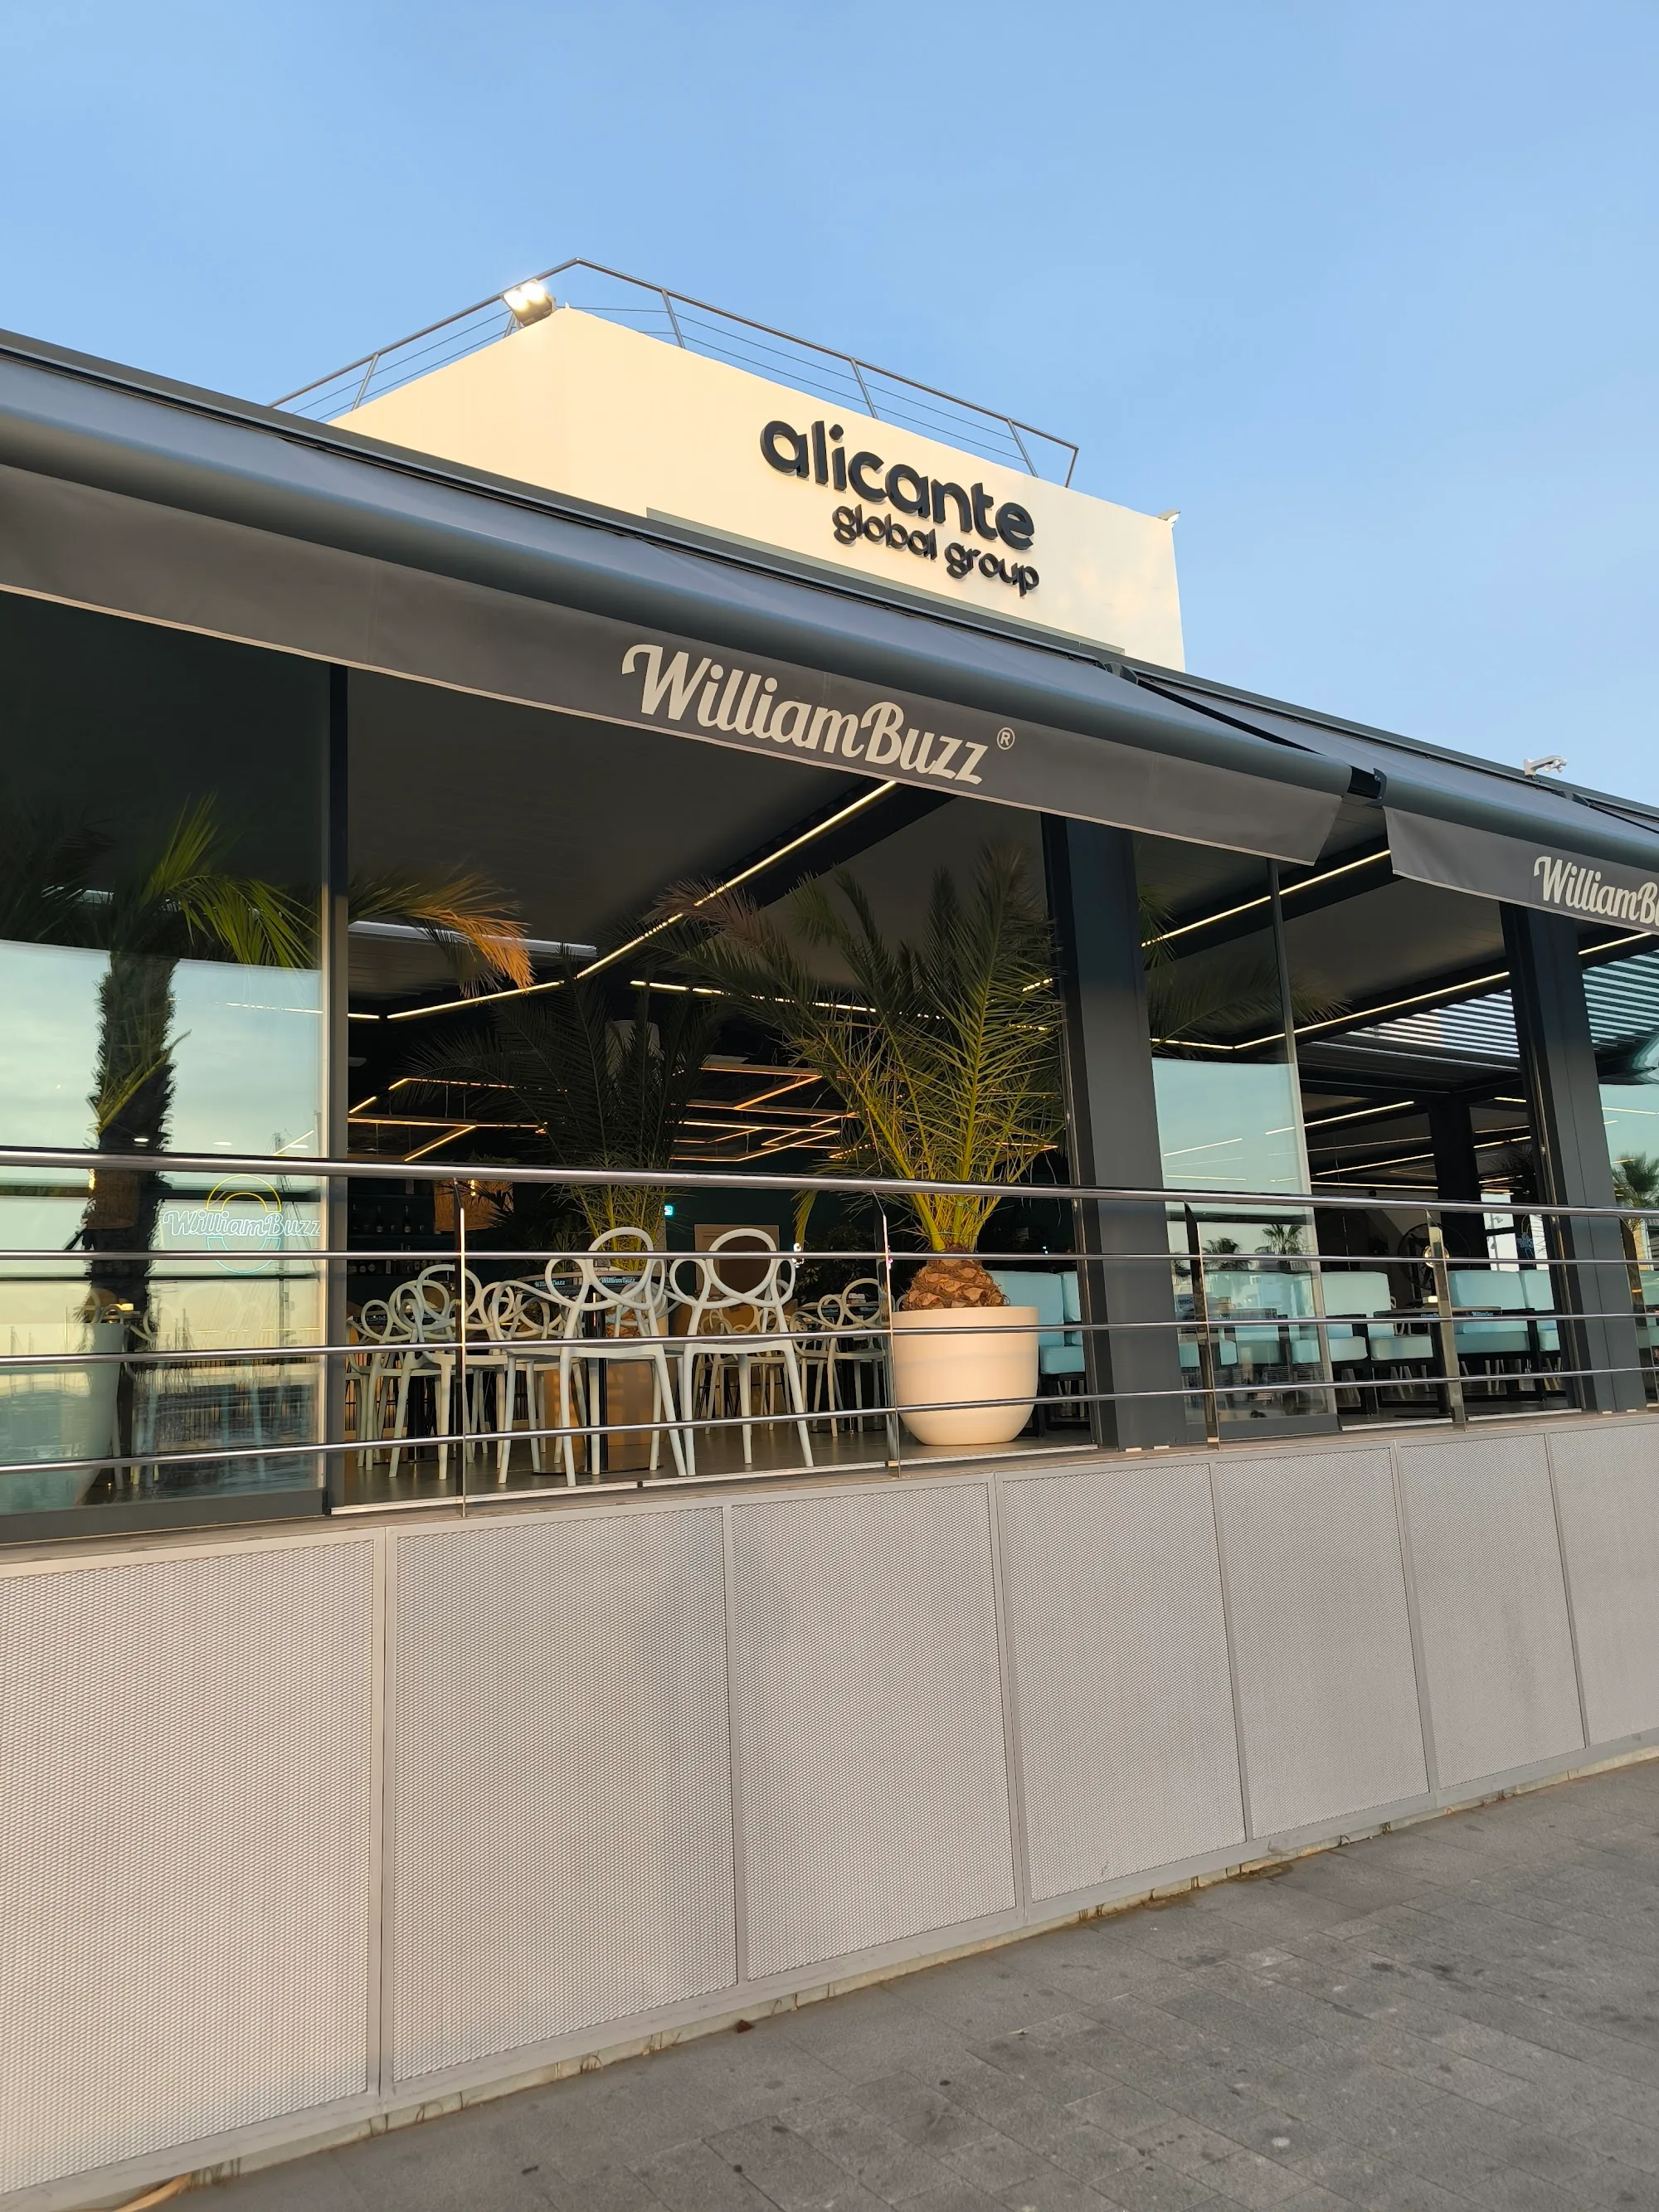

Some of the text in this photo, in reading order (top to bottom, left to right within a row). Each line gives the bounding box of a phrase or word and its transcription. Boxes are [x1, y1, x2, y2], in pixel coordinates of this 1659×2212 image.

[760, 420, 1035, 551] alicante
[832, 504, 1039, 597] global group
[621, 644, 989, 785] WilliamBuzz
[1534, 856, 1659, 927] WilliamB
[162, 1209, 322, 1237] WilliamBuzz
